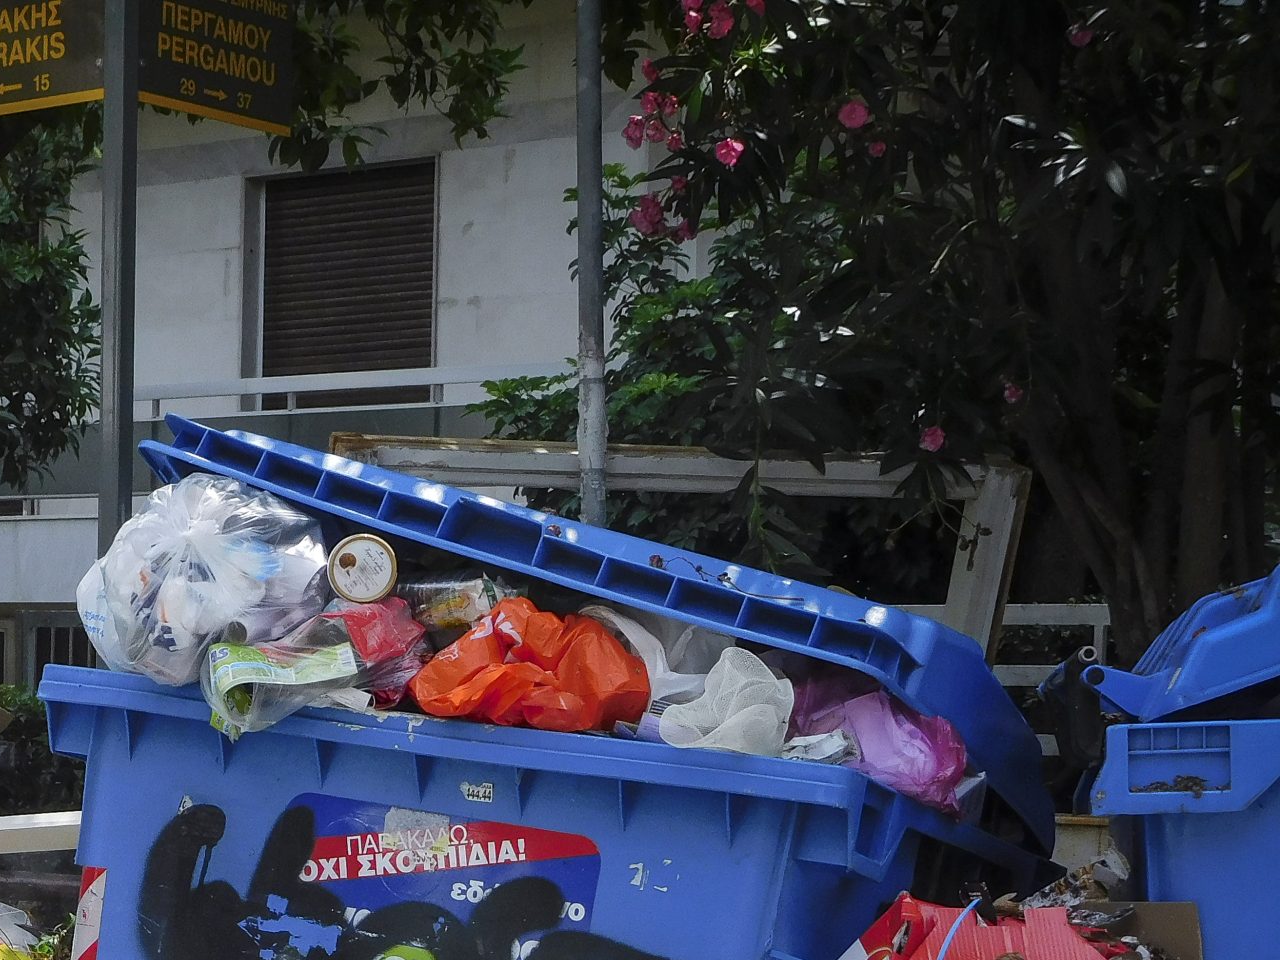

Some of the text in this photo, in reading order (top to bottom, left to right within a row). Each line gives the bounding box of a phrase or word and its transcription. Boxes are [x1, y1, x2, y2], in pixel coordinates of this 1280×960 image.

[162, 0, 272, 53] ΠΕΡΓΑΜΟΥ
[157, 31, 276, 87] PERGAMOU
[32, 74, 50, 93] 15
[179, 78, 252, 110] 29 37
